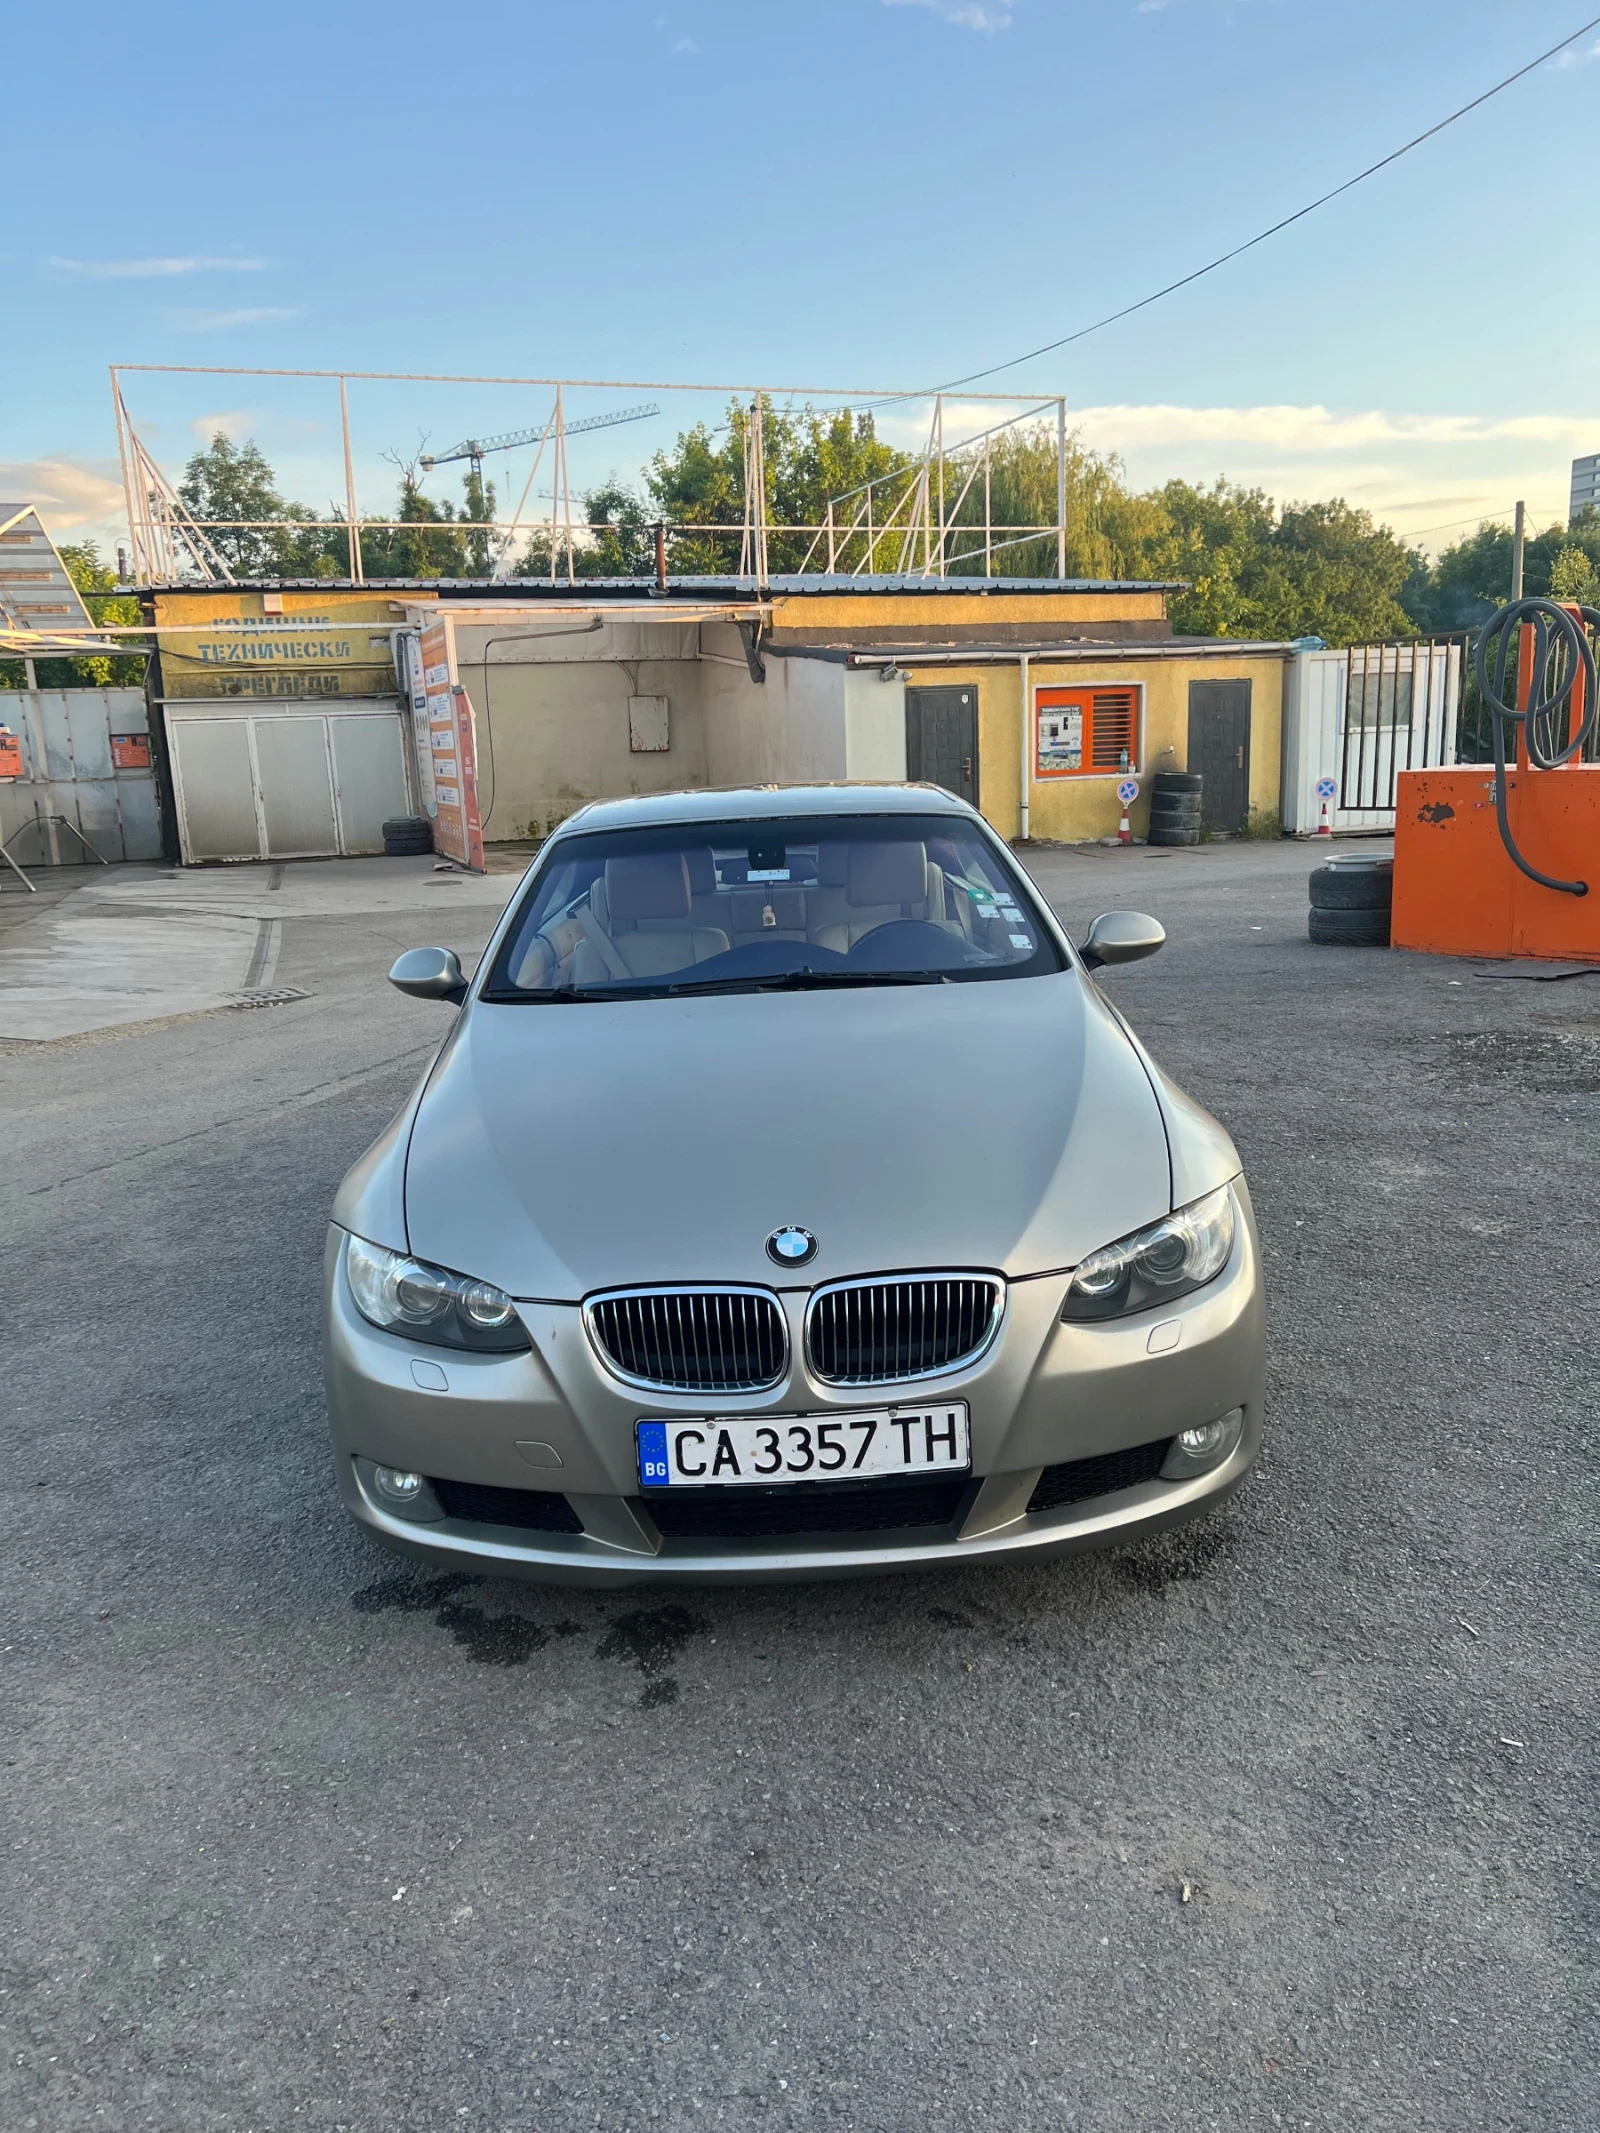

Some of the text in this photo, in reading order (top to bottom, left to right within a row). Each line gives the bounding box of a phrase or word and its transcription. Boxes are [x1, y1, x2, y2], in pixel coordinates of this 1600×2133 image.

[198, 641, 350, 662] ТЕХНИЧЕСКИ
[772, 1226, 813, 1240] BMW
[674, 1413, 957, 1476] CA 3357 TH
[645, 1462, 666, 1477] BG
